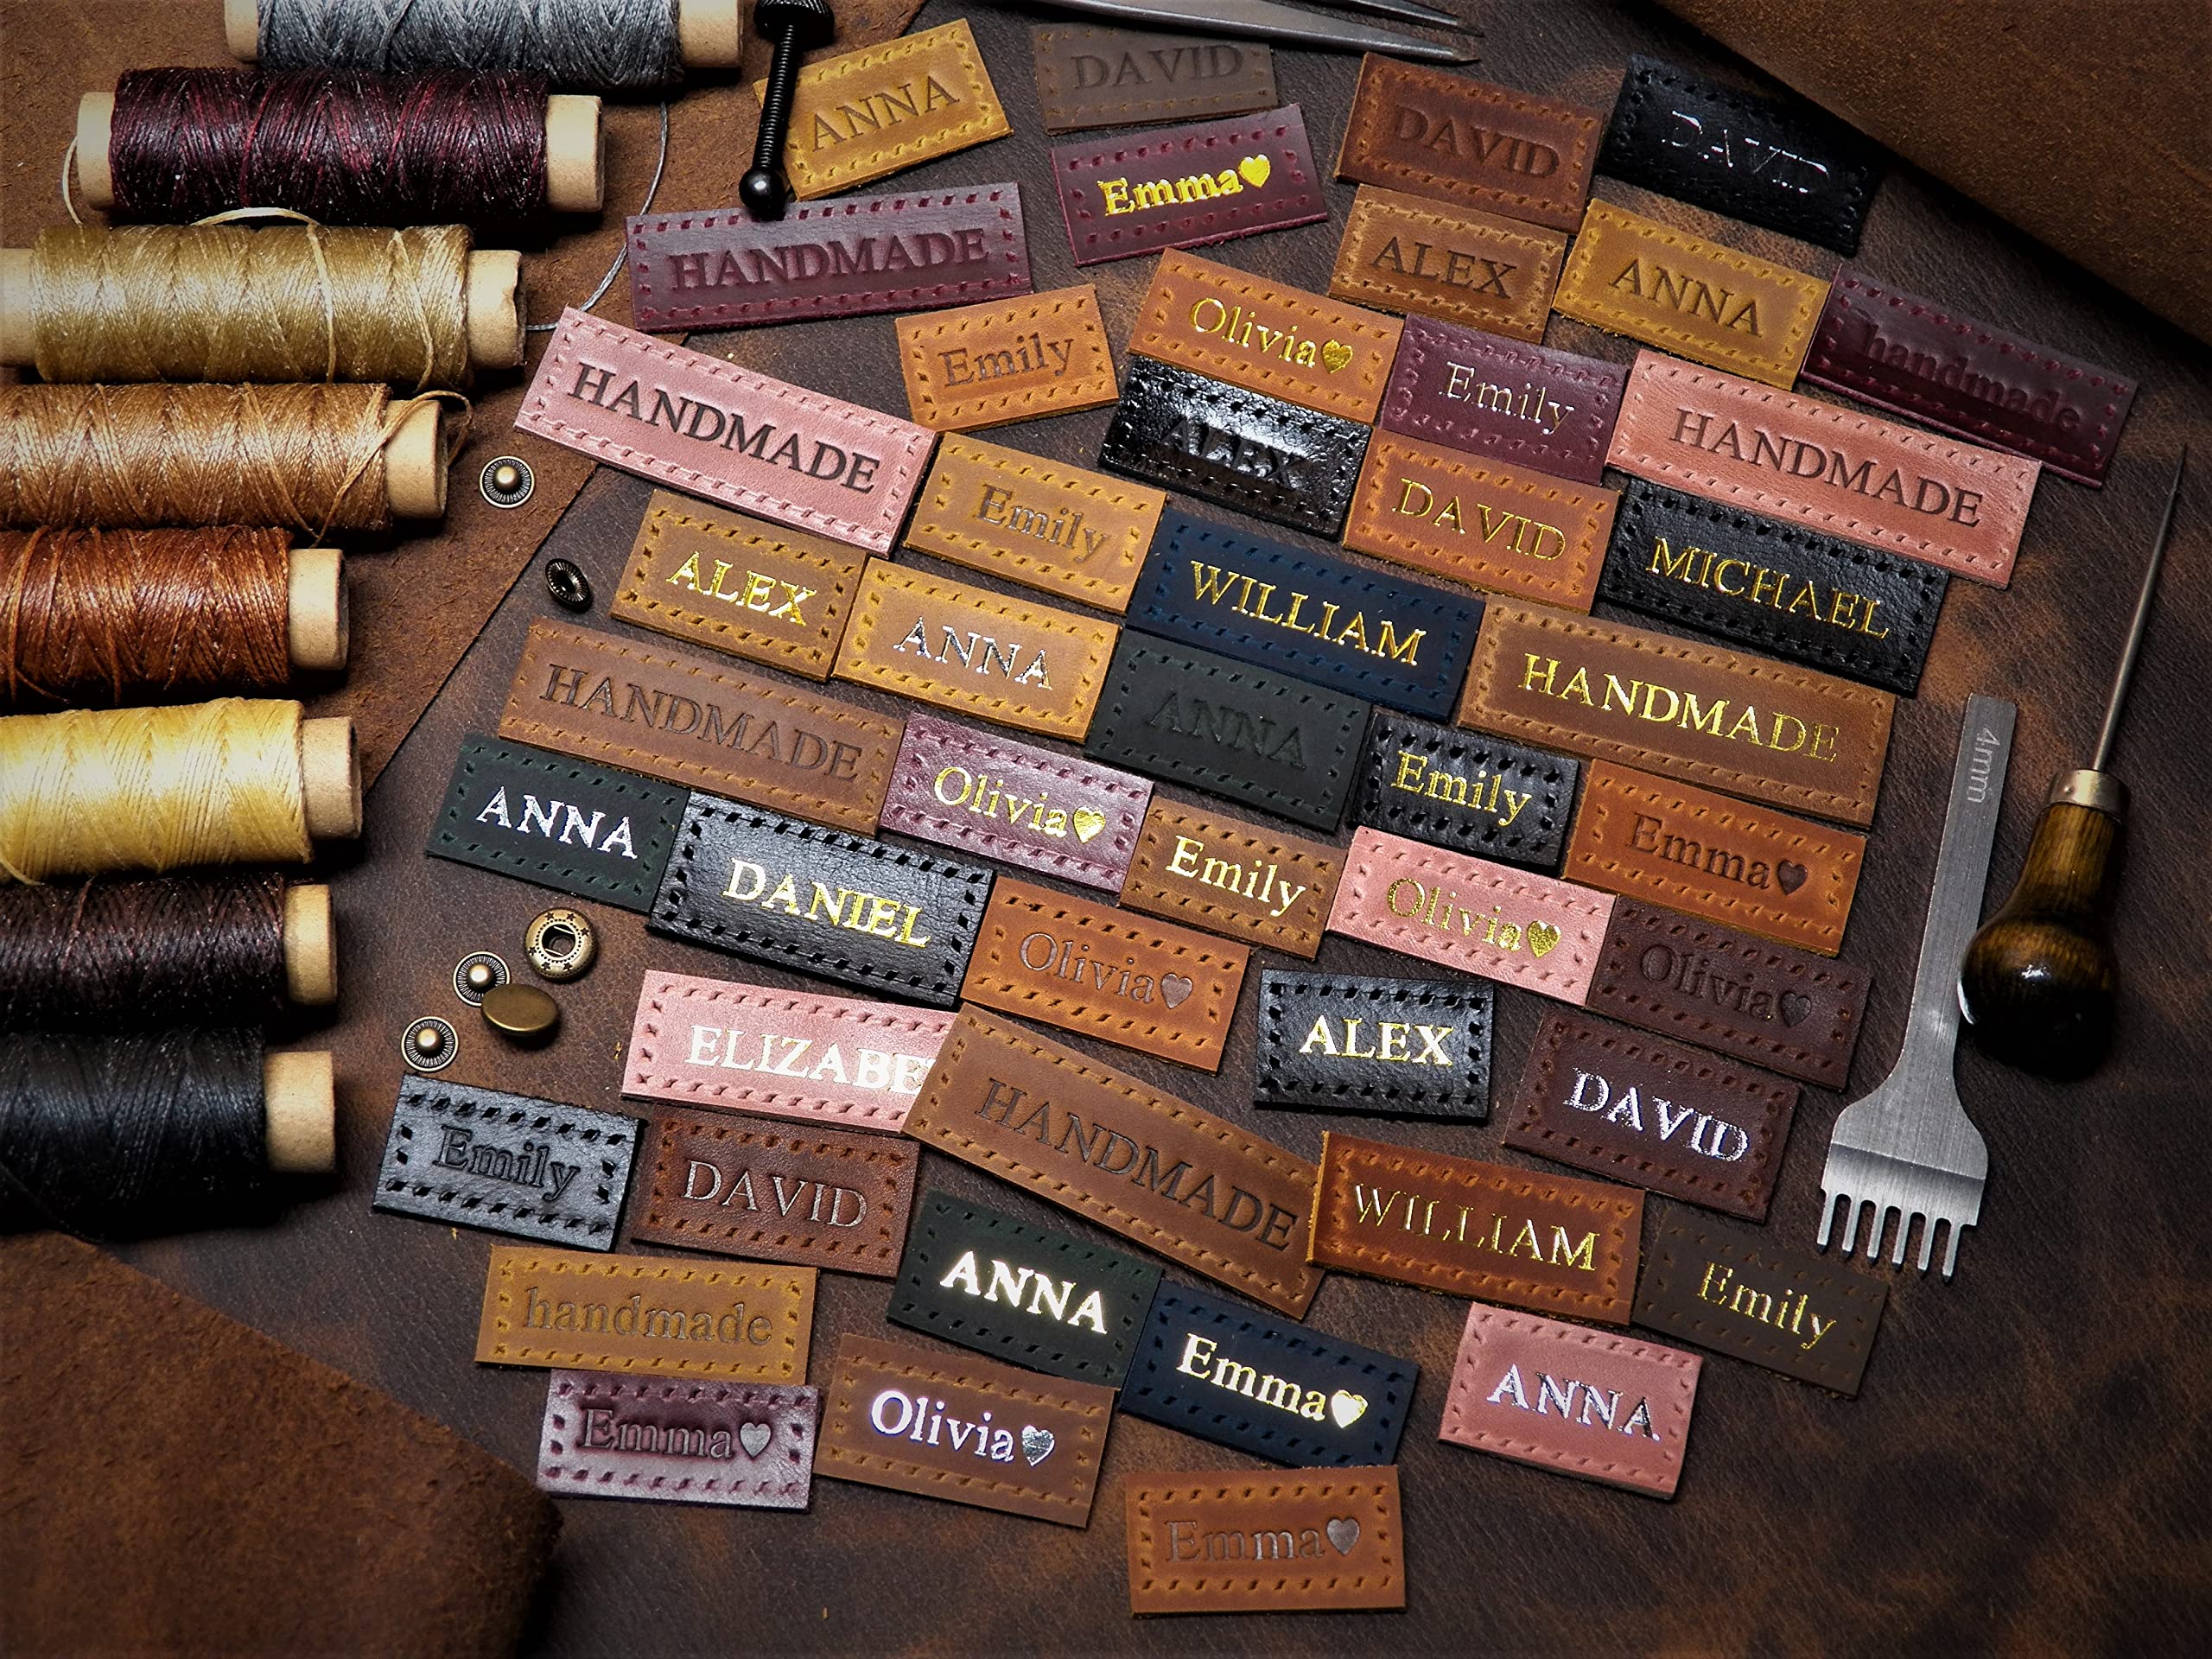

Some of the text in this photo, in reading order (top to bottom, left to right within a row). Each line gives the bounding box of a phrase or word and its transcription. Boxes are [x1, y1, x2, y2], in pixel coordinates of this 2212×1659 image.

[1071, 44, 1243, 89] DAVID
[811, 75, 960, 152] ANNA
[1394, 104, 1559, 175] DAVID
[1096, 166, 1243, 217] Emma
[670, 228, 989, 289] HANDMADE
[1374, 236, 1517, 300] ALEX
[1190, 297, 1316, 369] Olivia
[1609, 258, 1764, 338] ANNA
[938, 333, 1074, 388] Emily
[1439, 361, 1575, 435] Emily
[1854, 308, 2080, 430] handmade
[567, 362, 880, 493] HANDMADE
[1159, 414, 1306, 491] ALEX
[1670, 407, 1984, 528] HANDMADE
[971, 483, 1110, 564] Emily
[1392, 478, 1567, 562] DAVID
[666, 550, 817, 626] ALEX
[1191, 560, 1428, 666] WILLIAM
[1645, 537, 1890, 640] MICHAEL
[893, 616, 1053, 690] ANNA
[539, 664, 863, 782] HANDMADE
[1147, 692, 1306, 771] ANNA
[1522, 652, 1840, 764] HANDMADE
[933, 766, 1068, 838] Olivia
[1391, 750, 1532, 826] Emily
[1966, 727, 2000, 804] 4mm
[476, 786, 639, 860] ANNA
[1625, 812, 1770, 890] Emma
[722, 858, 931, 948] DANIEL
[1166, 835, 1306, 918] Emily
[1387, 877, 1522, 954] Olivia
[1020, 932, 1154, 1004] Olivia
[1640, 944, 1773, 1021] Olivia
[685, 1024, 937, 1096] ELIZABE
[1300, 1014, 1453, 1068] ALEX
[1563, 1067, 1749, 1162] DAVID
[434, 1123, 580, 1205] Emily
[683, 1160, 868, 1229] DAVID
[975, 1077, 1298, 1252] HANDMADE
[1355, 1183, 1600, 1272] WILLIAM
[524, 1287, 772, 1345] handmade
[939, 1249, 1108, 1336] ANNA
[1697, 1261, 1836, 1351] Emily
[1176, 1332, 1325, 1423] Emma
[1486, 1363, 1660, 1442] ANNA
[576, 1408, 735, 1459] Emma
[870, 1389, 1015, 1462] Olivia
[1165, 1520, 1325, 1562] Emma
